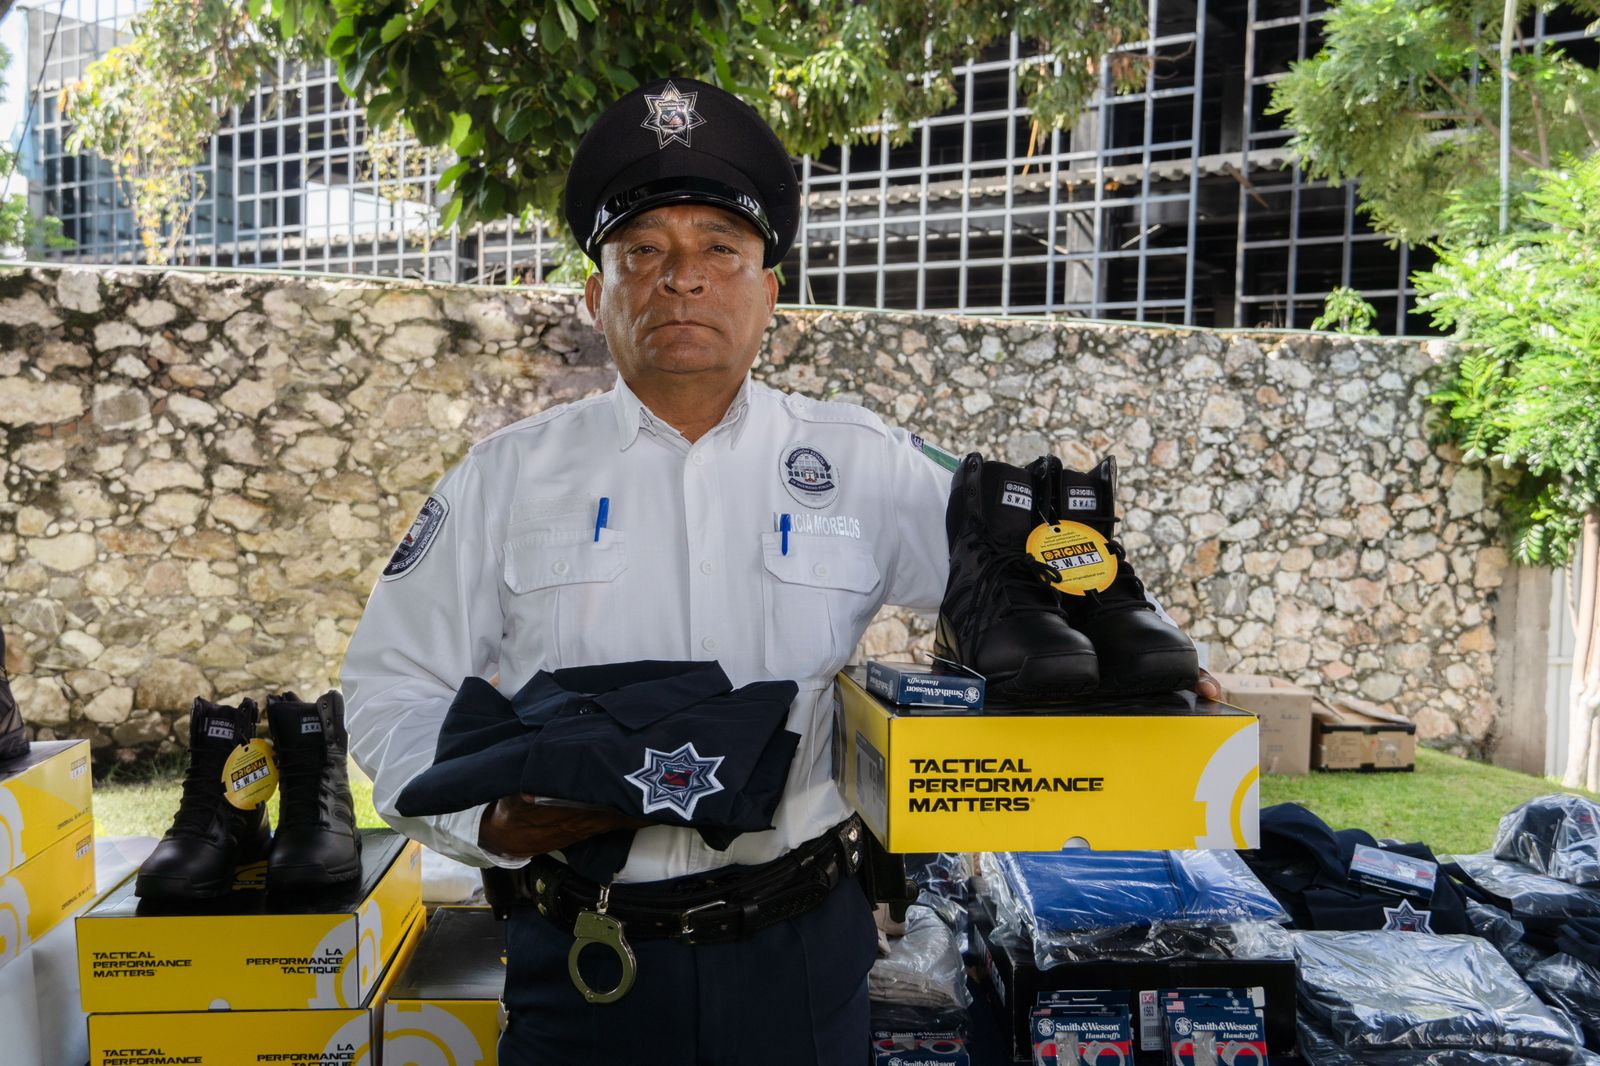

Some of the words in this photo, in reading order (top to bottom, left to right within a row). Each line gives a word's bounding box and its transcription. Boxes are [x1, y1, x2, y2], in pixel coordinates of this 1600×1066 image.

[814, 515, 860, 539] MORELOS
[1043, 543, 1096, 560] ORIGINAL
[231, 757, 268, 781] ORIGINAL
[909, 758, 1032, 773] TACTICAL
[908, 777, 1104, 793] PERFORMANCE
[93, 951, 155, 960] TACTICAL
[325, 948, 343, 956] LA
[93, 960, 192, 968] PERFORMANCE
[246, 957, 343, 966] PERFORMANCE
[93, 969, 156, 978] MATTERS
[281, 966, 341, 975] TACTIQUE
[1085, 1032, 1120, 1040] Handcuffs
[1223, 1032, 1259, 1040] Handcuffs
[103, 1048, 165, 1056] TACTICAL
[103, 1056, 202, 1066] PERFORMANCE
[257, 1052, 355, 1062] PERFORMANCE
